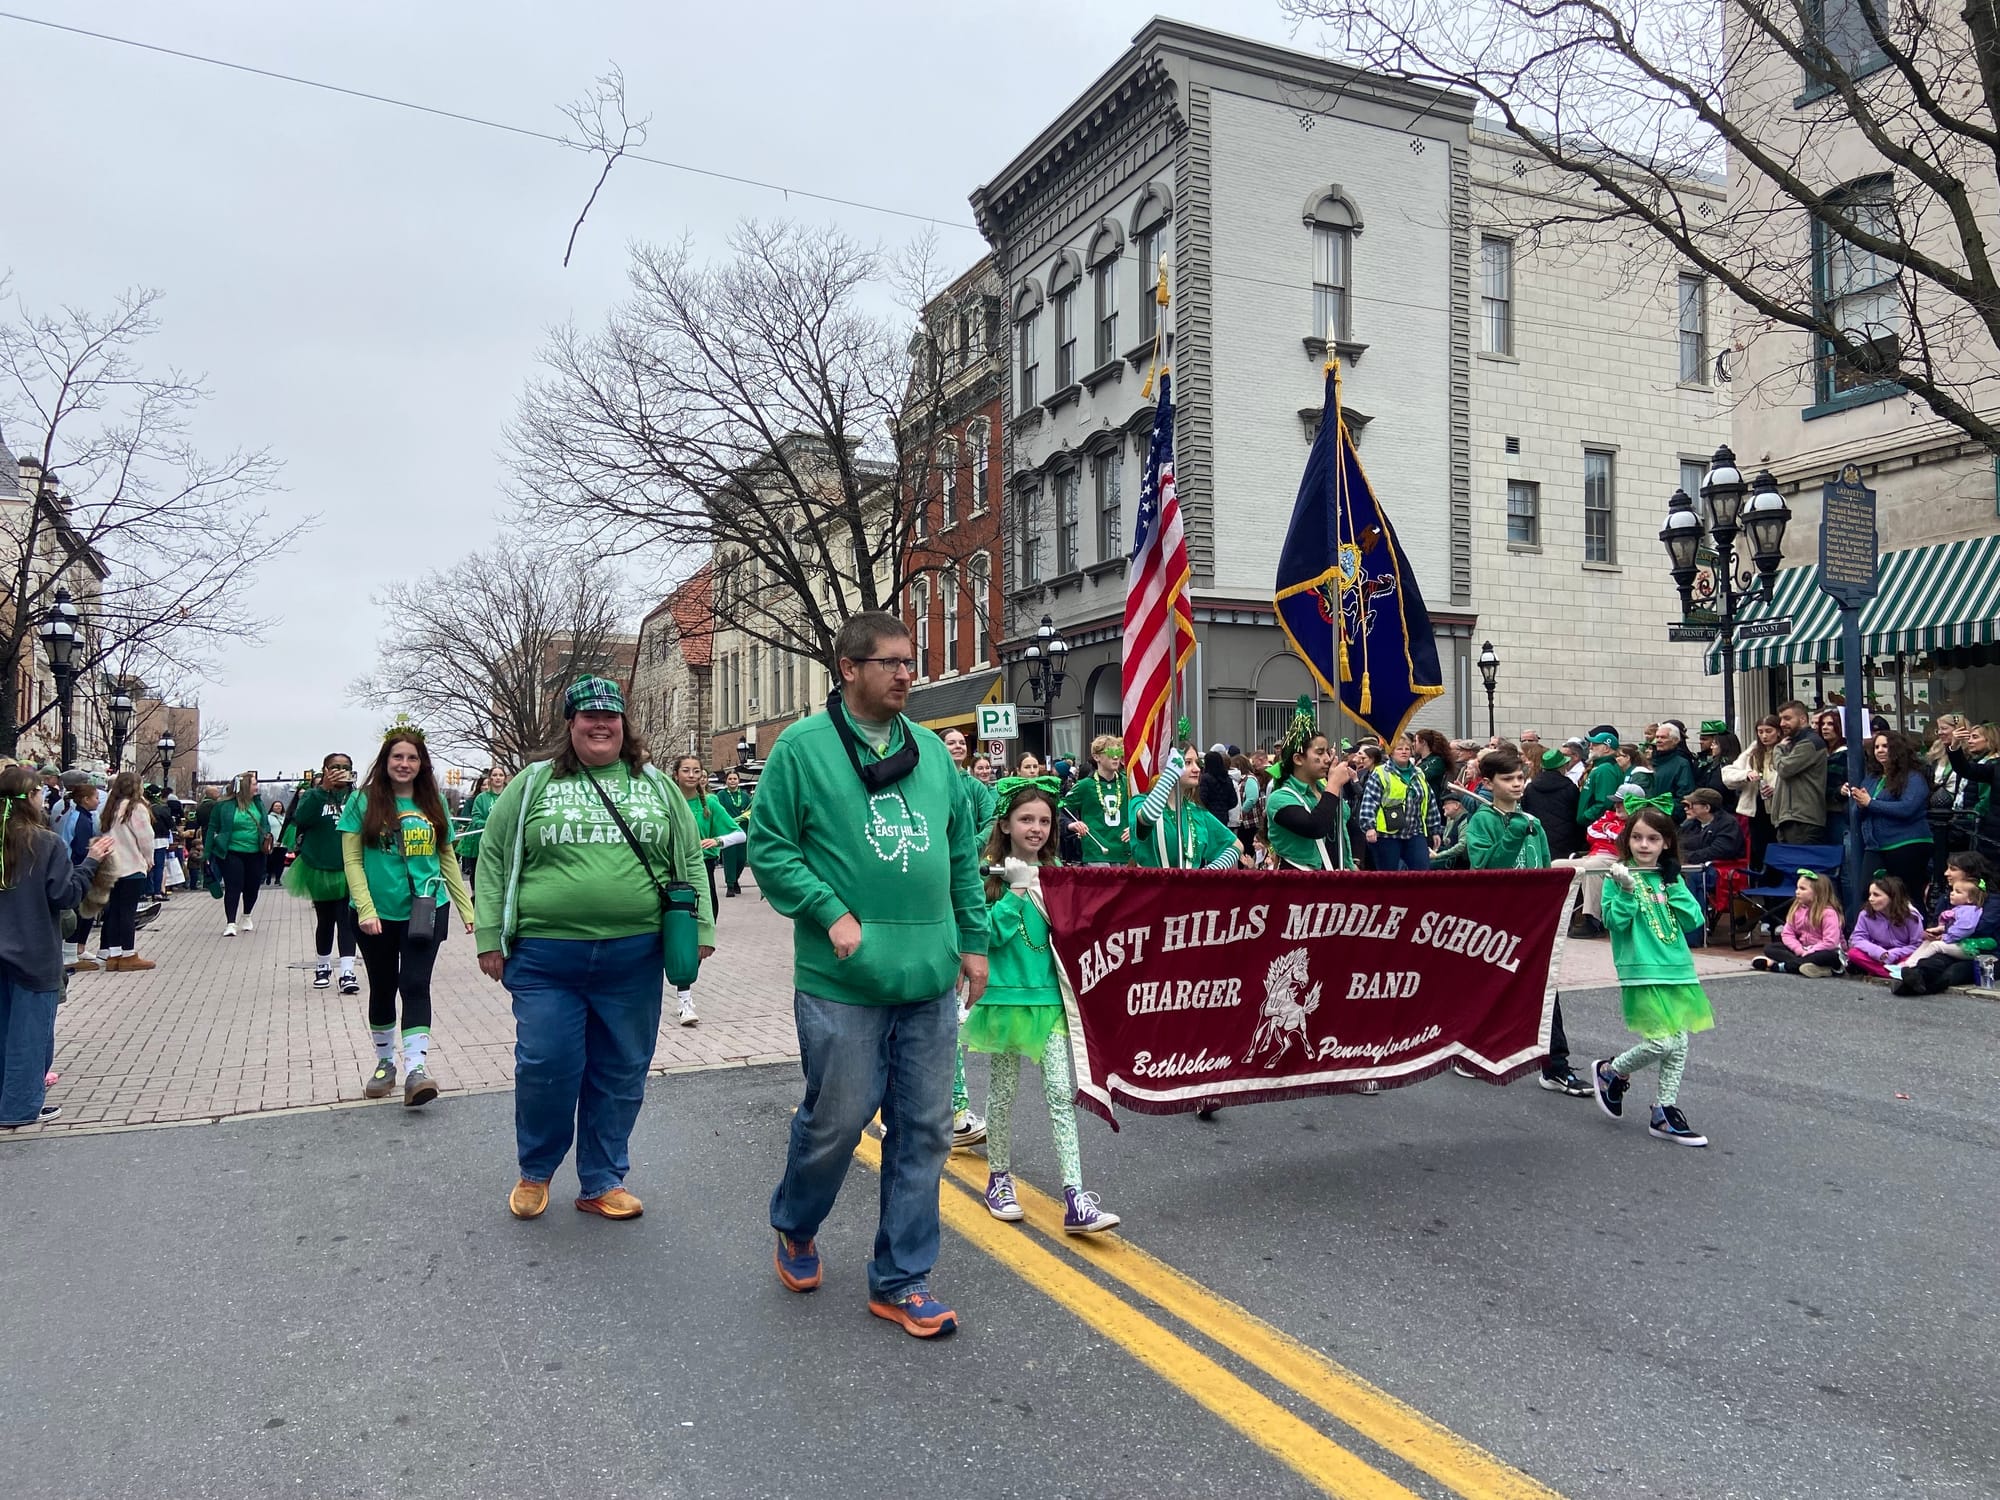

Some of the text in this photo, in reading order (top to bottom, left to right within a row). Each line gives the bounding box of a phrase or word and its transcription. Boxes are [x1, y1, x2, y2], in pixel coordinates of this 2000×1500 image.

[1751, 624, 1780, 633] MAIN ST
[626, 780, 652, 794] TO
[403, 827, 430, 844] ucky
[875, 825, 898, 836] EAST
[1078, 902, 1522, 995] EAST HILLS MIDDLE SCHOOL
[1127, 971, 1421, 1016] CHARGER BAND
[1132, 1024, 1442, 1078] Bethlehem Pennsylvania
